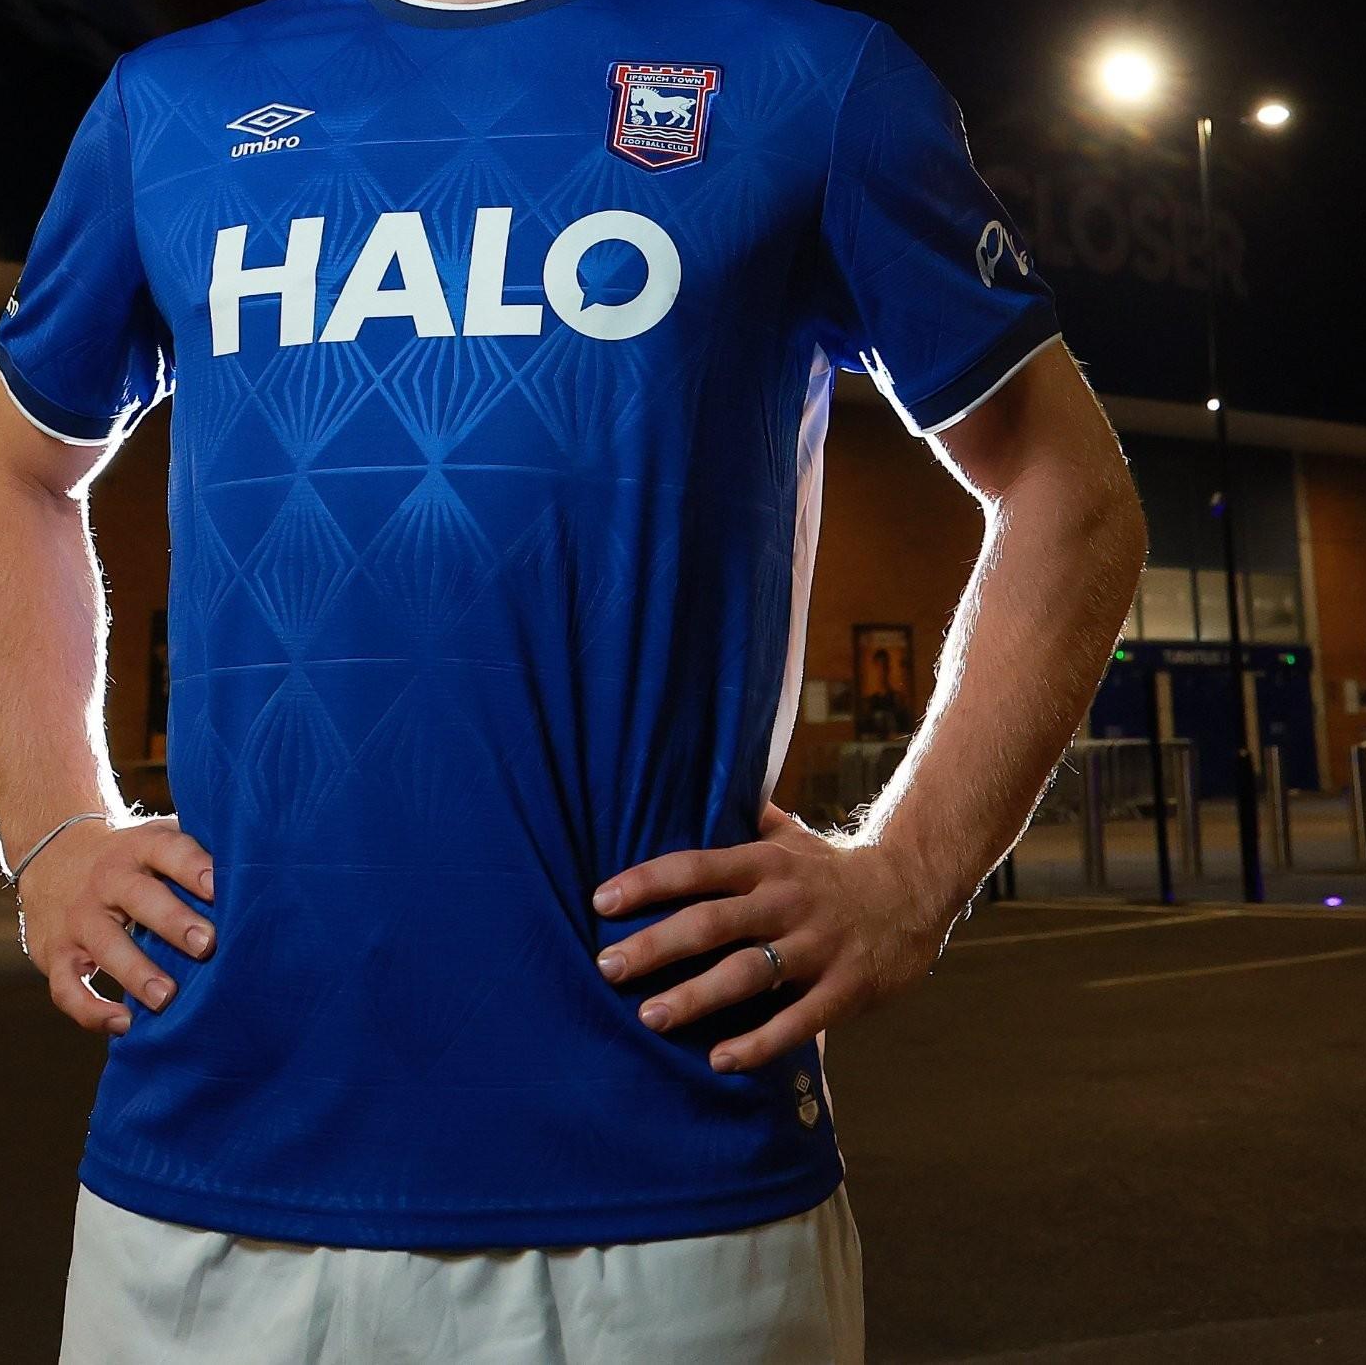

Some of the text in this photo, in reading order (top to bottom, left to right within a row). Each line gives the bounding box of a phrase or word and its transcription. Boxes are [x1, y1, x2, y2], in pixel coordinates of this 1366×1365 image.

[629, 74, 702, 85] IPSWICH TOWN
[231, 136, 300, 158] umbro
[623, 138, 689, 152] FOOTBALL CLUB
[208, 206, 682, 357] HALO
